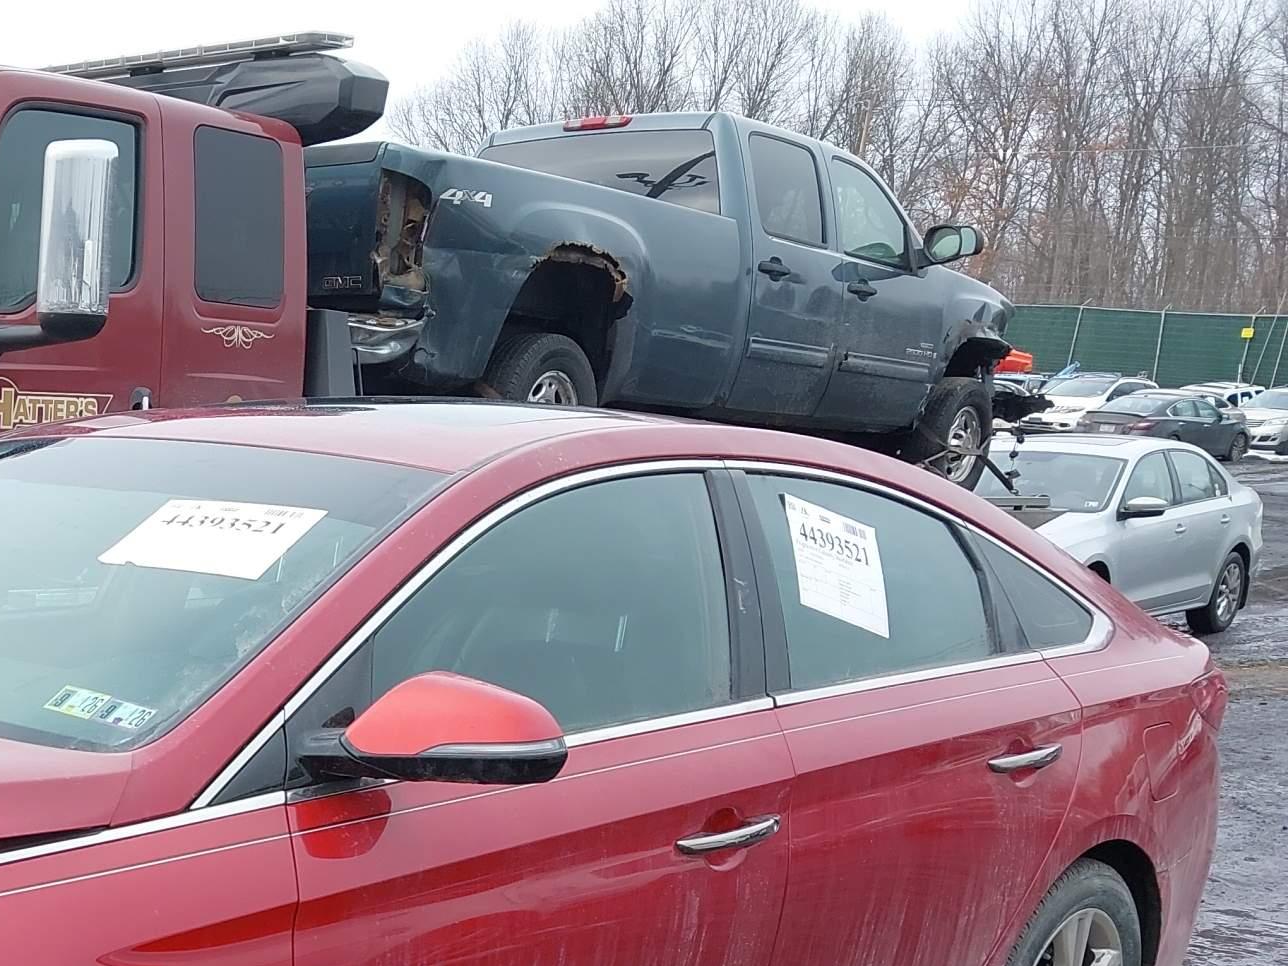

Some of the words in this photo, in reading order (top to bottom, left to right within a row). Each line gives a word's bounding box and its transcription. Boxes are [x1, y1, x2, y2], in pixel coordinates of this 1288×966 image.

[323, 276, 362, 289] GMC
[160, 514, 286, 534] 44393521
[799, 522, 870, 566] 44393521
